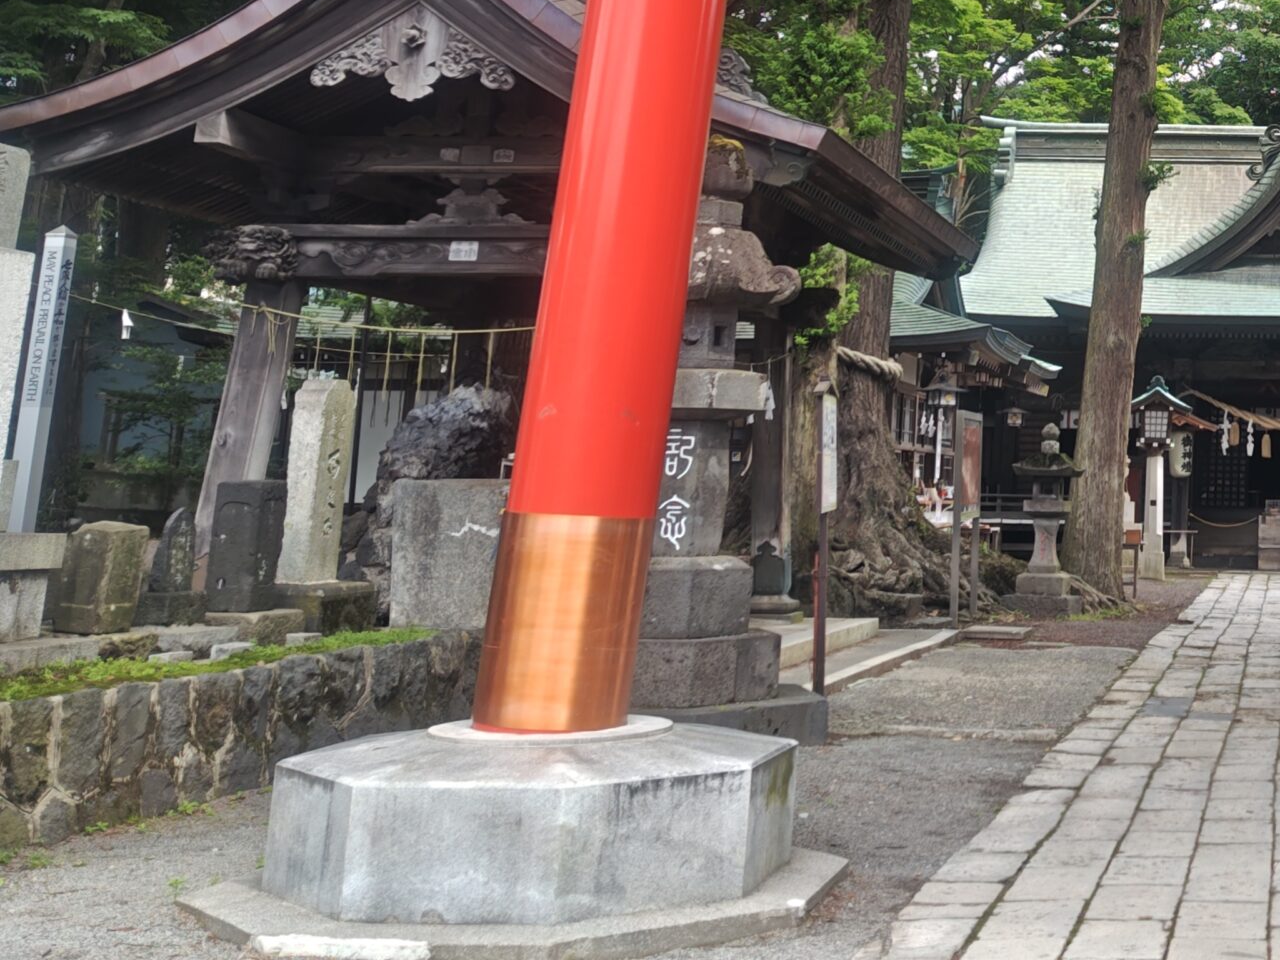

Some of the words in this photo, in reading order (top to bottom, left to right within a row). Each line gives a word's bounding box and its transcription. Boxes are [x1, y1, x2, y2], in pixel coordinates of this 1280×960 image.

[47, 251, 57, 275] MAY
[40, 275, 54, 305] PEACE
[35, 309, 49, 346] PREVAIL
[26, 365, 40, 402] EARTH
